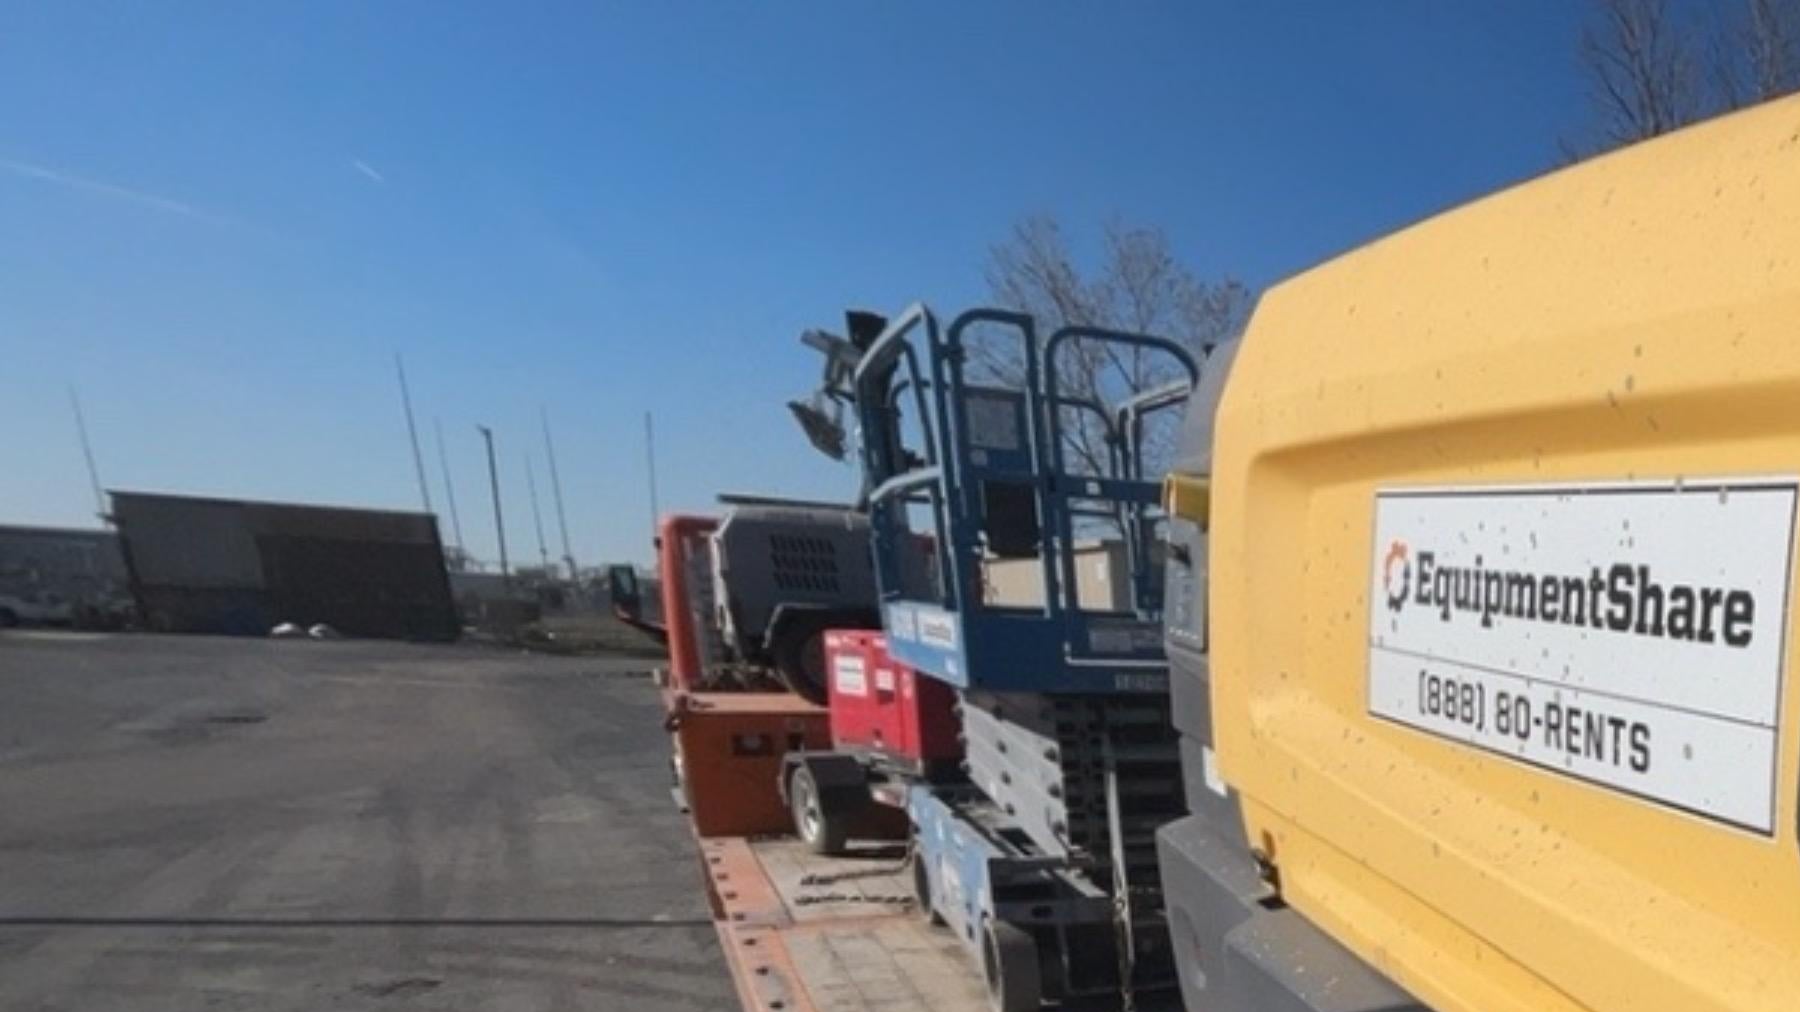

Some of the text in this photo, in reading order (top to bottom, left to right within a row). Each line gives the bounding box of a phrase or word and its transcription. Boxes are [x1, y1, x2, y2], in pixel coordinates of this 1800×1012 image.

[1415, 551, 1755, 648] EquipmentShare
[1418, 669, 1651, 774] (888) 80-RENTS
